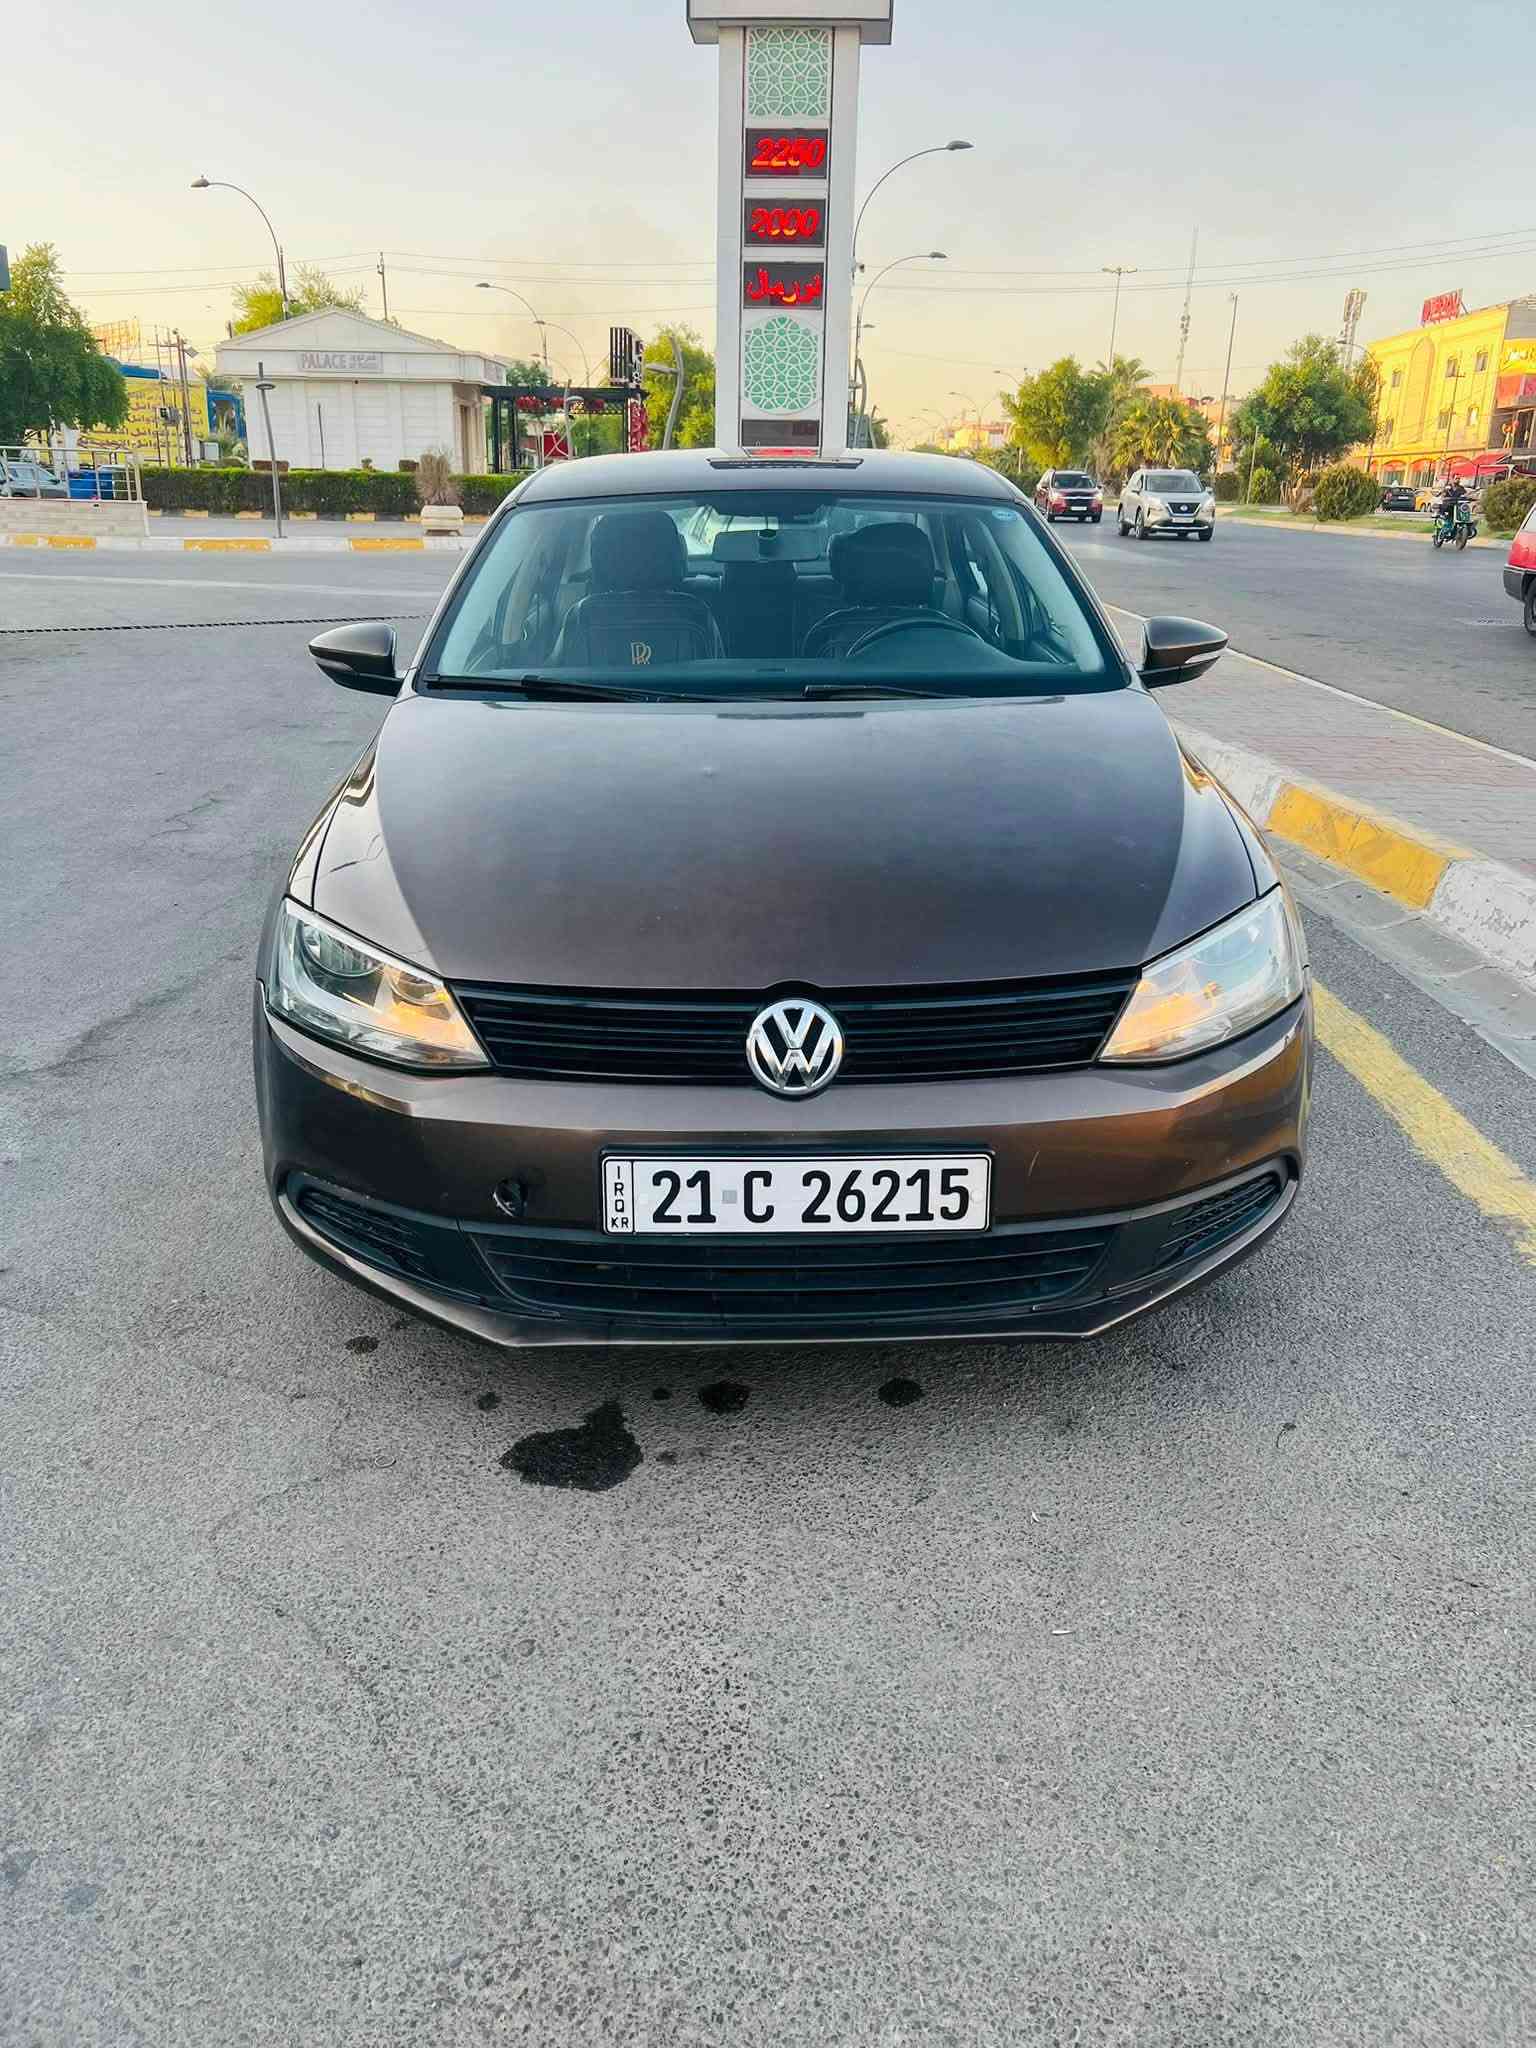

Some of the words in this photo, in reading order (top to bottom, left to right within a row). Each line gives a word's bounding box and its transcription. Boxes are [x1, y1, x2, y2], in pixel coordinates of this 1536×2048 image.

[752, 136, 826, 168] 2250
[752, 207, 821, 239] 2000
[302, 353, 347, 369] PALACE
[652, 1170, 716, 1223] 21
[743, 1170, 775, 1223] C
[801, 1168, 970, 1223] 26215
[611, 1216, 629, 1229] KR
